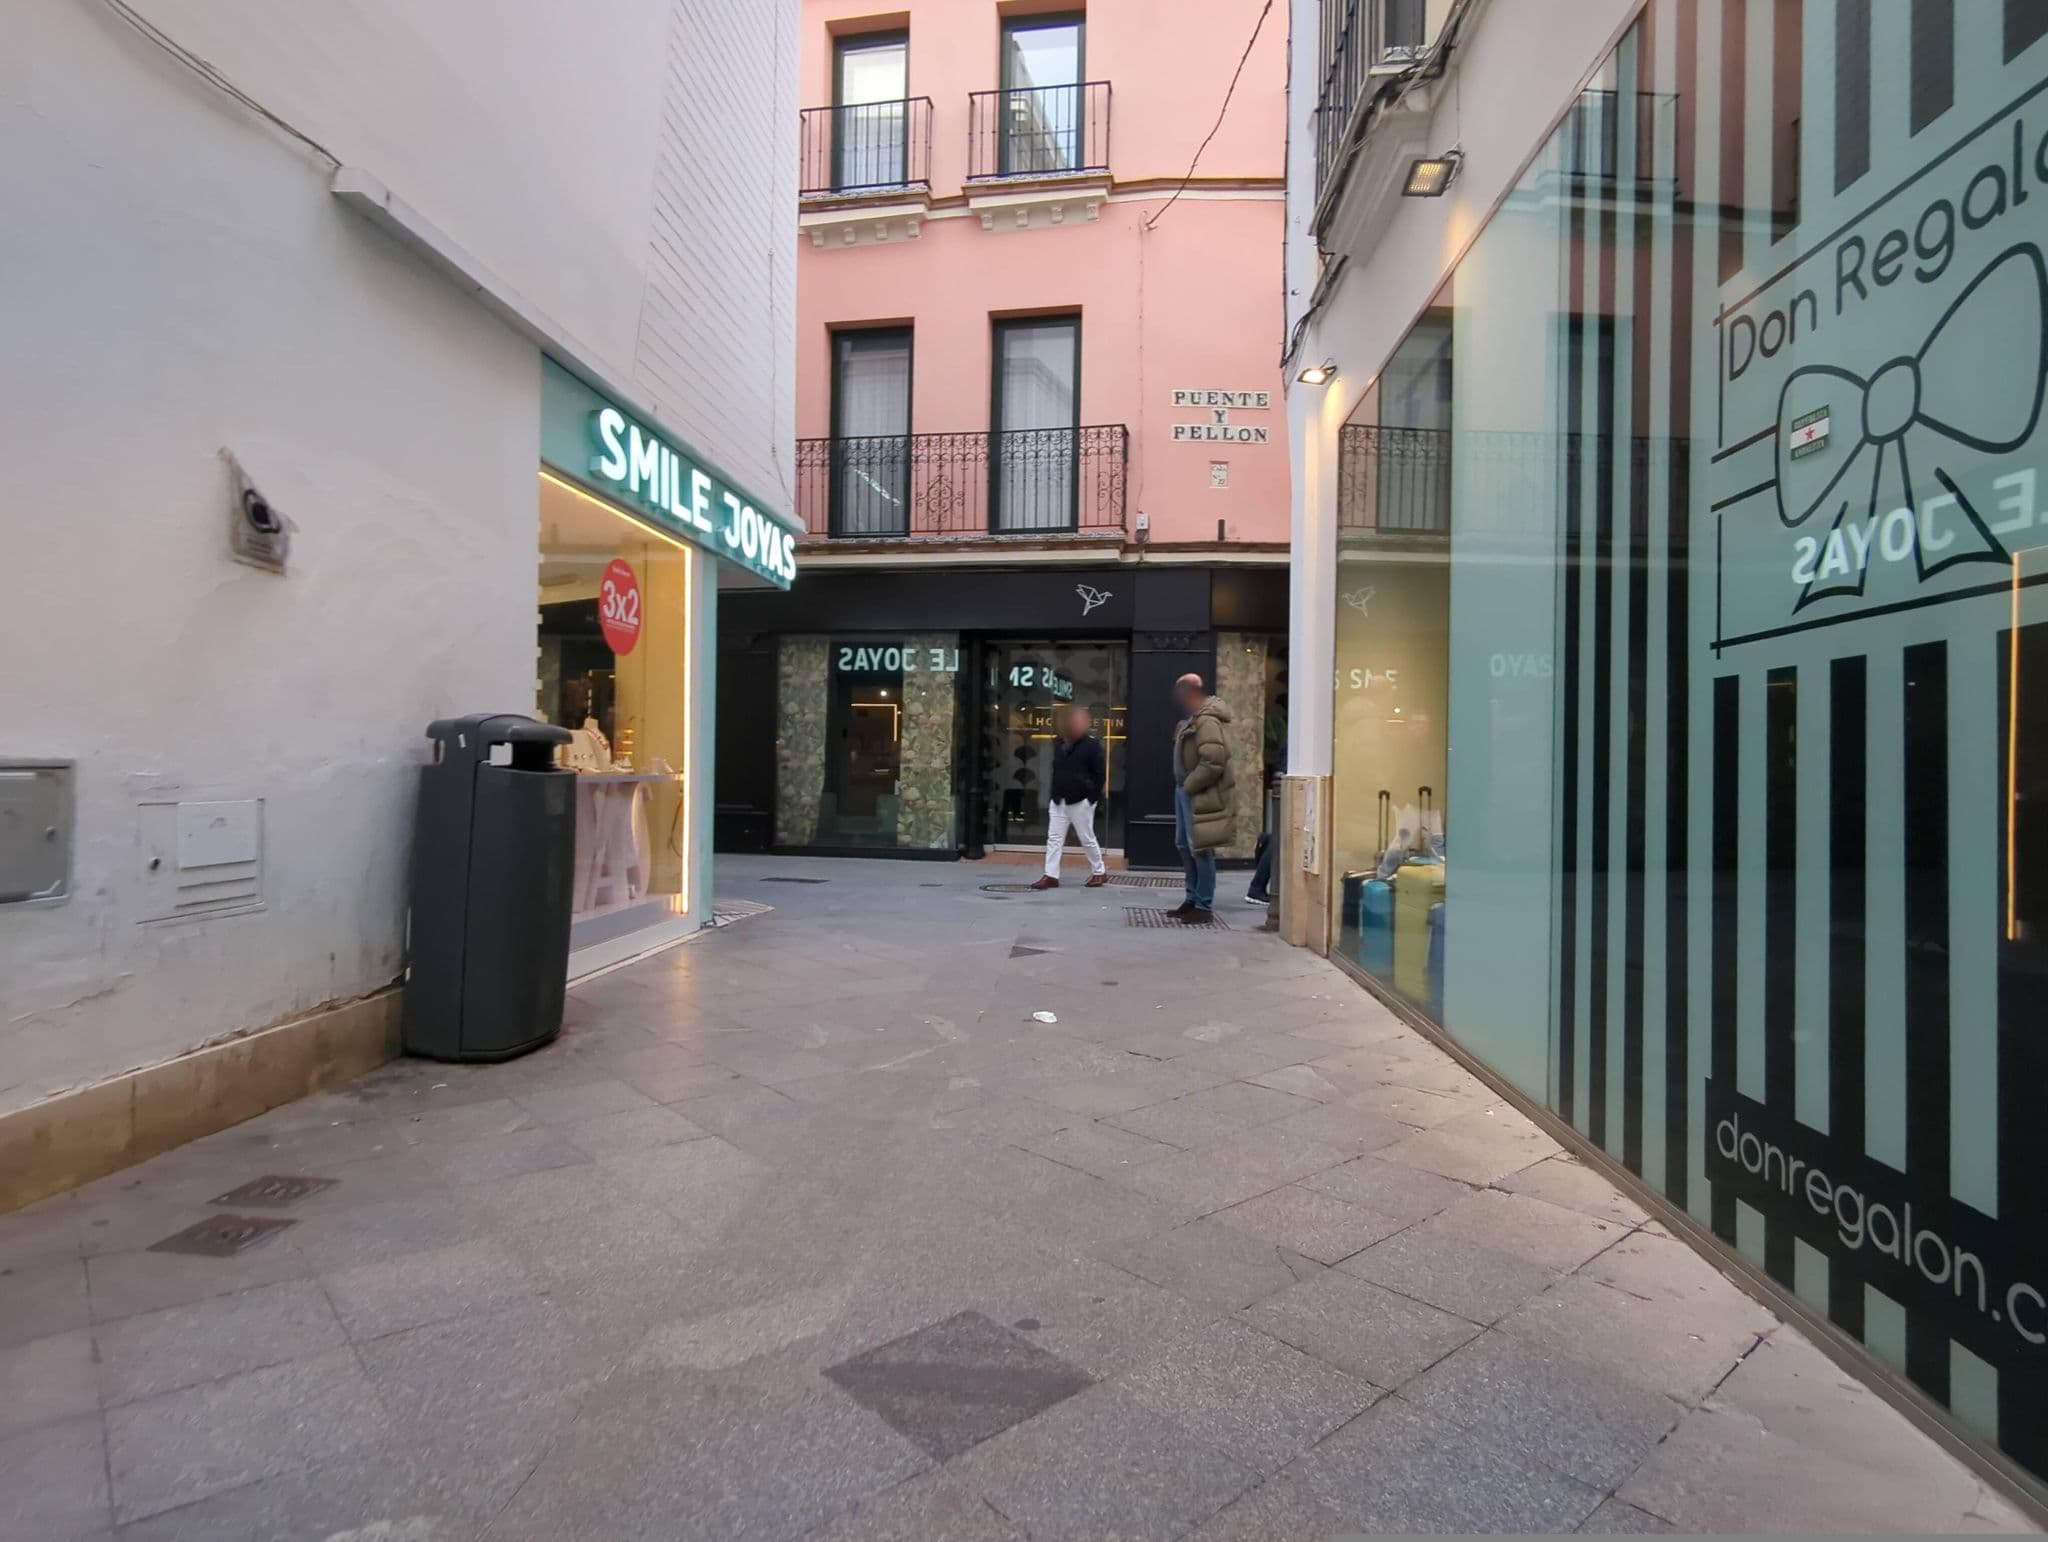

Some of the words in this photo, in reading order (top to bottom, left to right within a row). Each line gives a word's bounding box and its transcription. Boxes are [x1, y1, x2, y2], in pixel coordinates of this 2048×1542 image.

[1729, 288, 1817, 382] Don
[1173, 391, 1269, 407] PUENTE
[1213, 410, 1226, 423] Y
[1173, 426, 1267, 442] PELLON
[599, 407, 713, 534] SMILE
[723, 491, 797, 581] JOYAS
[603, 579, 640, 626] 3x2
